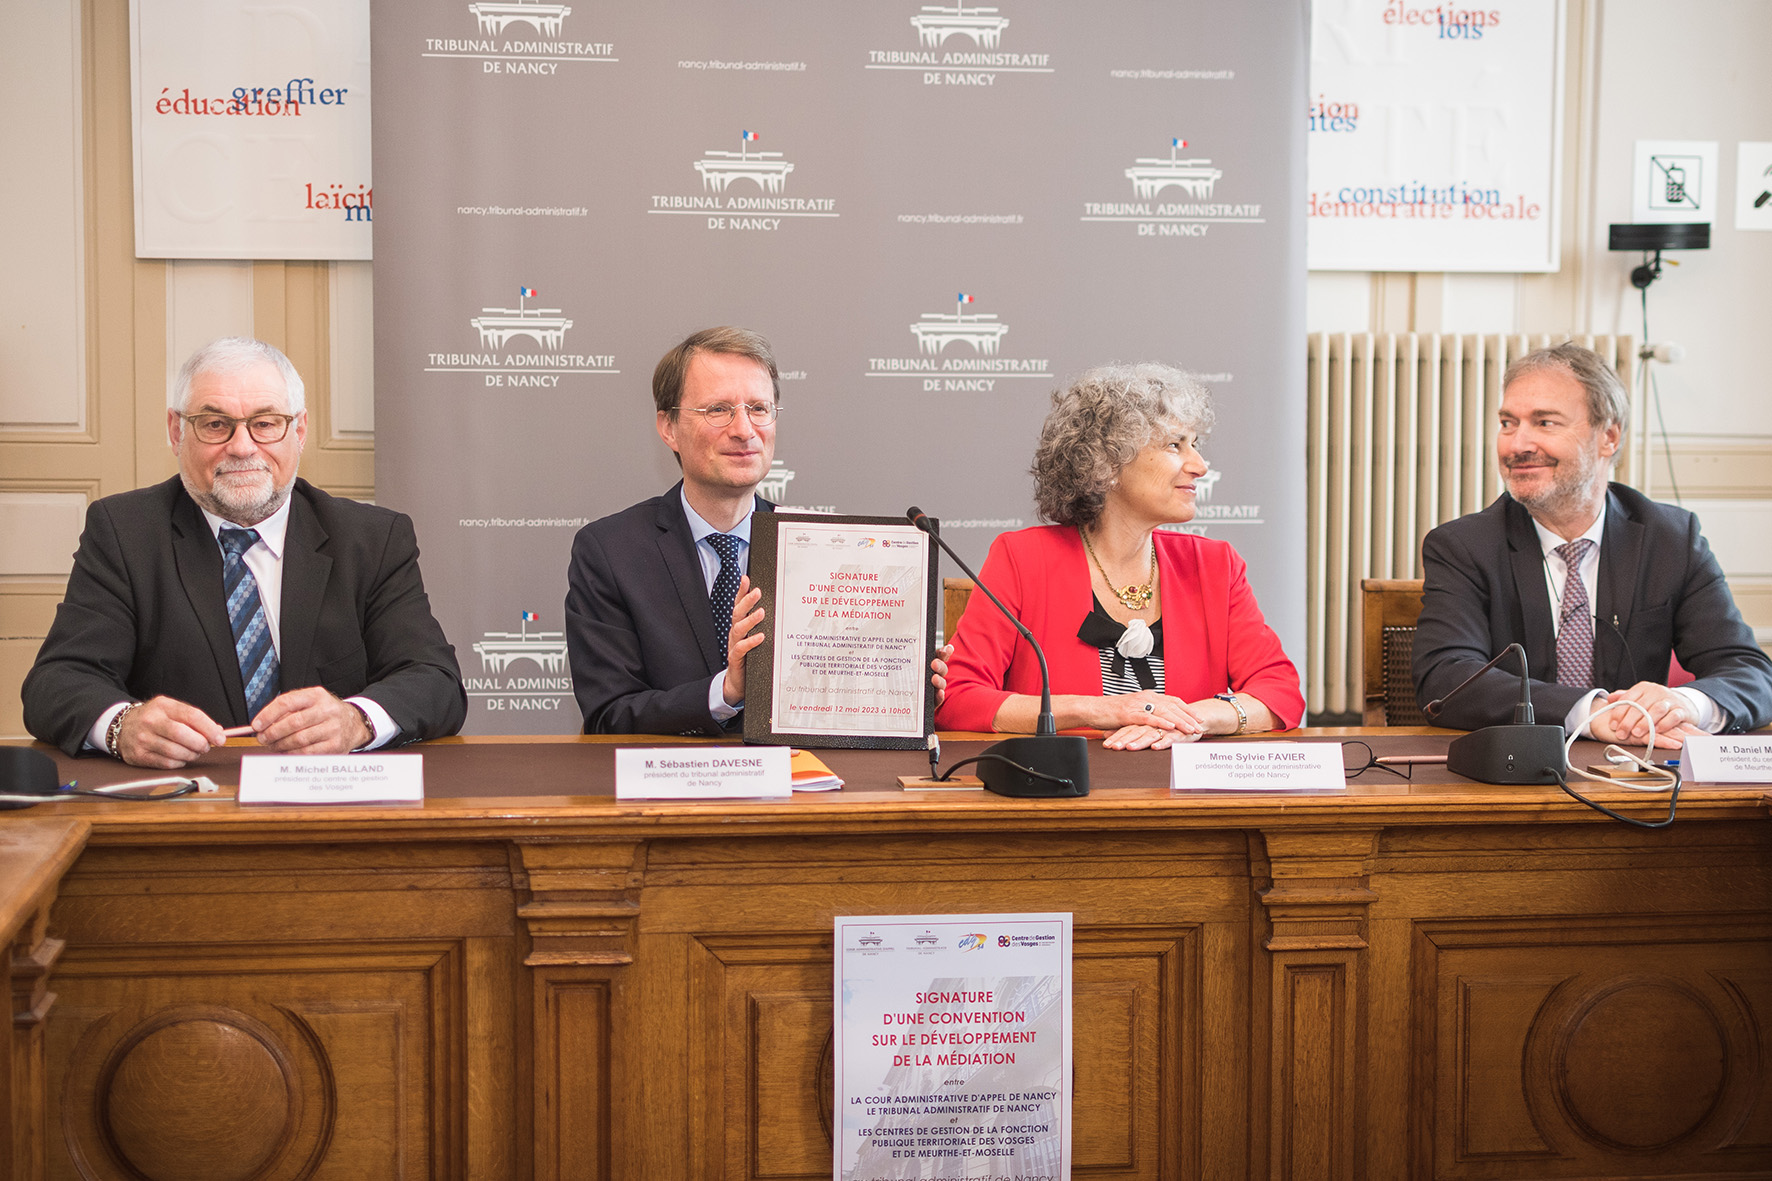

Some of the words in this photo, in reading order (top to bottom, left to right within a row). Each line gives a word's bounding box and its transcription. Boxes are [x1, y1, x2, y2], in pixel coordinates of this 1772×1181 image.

[1383, 0, 1501, 27] élections
[1438, 13, 1483, 40] lois
[426, 39, 498, 52] TRIBUNAL
[503, 41, 614, 55] ADMINISTRATIF
[678, 59, 807, 72] nancy.tribunal-administratif.fr
[868, 51, 938, 65] TRIBUNAL
[942, 52, 1049, 67] ADMINISTRATIF
[483, 62, 501, 73] DE
[506, 62, 557, 75] NANCY
[924, 72, 941, 85] DE
[946, 73, 996, 86] NANCY
[232, 78, 348, 111] greffier
[156, 88, 301, 116] éducation
[1339, 180, 1500, 206] constitution
[652, 196, 722, 209] TRIBUNAL
[726, 197, 835, 211] ADMINISTRATIF
[1085, 202, 1153, 216] TRIBUNAL
[1157, 204, 1262, 217] ADMINISTRATIF
[1463, 196, 1541, 220] locale
[457, 204, 588, 217] nancy.tribunal-administratif.fr
[707, 218, 726, 230] DE
[730, 218, 781, 231] NANCY
[897, 212, 1024, 225] nancy.tribunal-administratif.fr
[1138, 224, 1156, 236] DE
[1159, 224, 1209, 237] NANCY
[428, 353, 500, 366] TRIBUNAL
[504, 354, 615, 367] ADMINISTRATIF
[868, 358, 938, 371] TRIBUNAL
[942, 358, 1048, 372] ADMINISTRATIF
[485, 374, 503, 387] DE
[508, 375, 559, 388] NANCY
[924, 378, 941, 391] DE
[946, 378, 995, 391] NANCY
[830, 572, 878, 581] SIGNATURE
[809, 583, 835, 593] D'UNE
[837, 585, 898, 595] CONVENTION
[801, 596, 818, 605] SUR
[820, 597, 829, 605] LE
[832, 596, 905, 608] DÉVELOPPEMENT
[814, 609, 825, 618] DE
[828, 610, 839, 618] LA
[841, 608, 891, 620] MÉDIATION
[799, 686, 827, 694] tribunal
[828, 687, 875, 695] administratif
[876, 688, 887, 696] de
[888, 689, 914, 697] Nancy
[487, 699, 505, 711] DE
[510, 699, 561, 710] NANCY
[799, 704, 833, 712] vendredi
[889, 707, 911, 715] 10h00
[1720, 746, 1731, 754] M.
[1733, 746, 1762, 754] Daniel
[645, 761, 657, 769] M.
[660, 760, 710, 769] Sébastien
[713, 759, 763, 768] DAVESNE
[1210, 753, 1233, 761] Mme
[1236, 753, 1265, 763] Sylvie
[1268, 753, 1306, 761] FAVIER
[295, 765, 329, 774] Michel
[332, 765, 384, 773] BALLAND
[644, 771, 678, 779] président
[691, 770, 719, 778] tribunal
[1267, 771, 1290, 779] Nancy
[916, 991, 993, 1004] SIGNATURE
[883, 1012, 925, 1025] D'UNE
[929, 1011, 1025, 1024] CONVENTION
[872, 1034, 897, 1047] SUR
[902, 1034, 916, 1046] LE
[921, 1030, 1037, 1046] DÉVELOPPEMENT
[893, 1054, 911, 1067] DE
[915, 1054, 932, 1066] LA
[936, 1050, 1015, 1066] MÉDIATION
[944, 1078, 965, 1086] entre
[851, 1097, 862, 1105] LA
[865, 1096, 892, 1105] COUR
[894, 1094, 968, 1104] ADMINISTRATIVE
[972, 1094, 1007, 1102] D'APPEL
[1009, 1093, 1021, 1101] DE
[1023, 1092, 1057, 1101] NANCY
[867, 1107, 876, 1116] LE
[878, 1106, 921, 1116] TRIBUNAL
[923, 1105, 991, 1114] ADMINISTRATIF
[993, 1105, 1005, 1113] DE
[1007, 1104, 1041, 1113] NANCY
[950, 1116, 958, 1124] et
[858, 1128, 873, 1137] LES
[875, 1128, 914, 1136] CENTRES
[917, 1127, 928, 1135] DE
[931, 1126, 970, 1135] GESTION
[973, 1126, 984, 1134] DE
[987, 1126, 998, 1134] LA
[1000, 1125, 1049, 1134] FONCTION
[872, 1138, 915, 1148] PUBLIQUE
[917, 1137, 976, 1147] TERRITORIALE
[979, 1137, 995, 1145] DES
[998, 1136, 1035, 1145] VOSGES
[892, 1150, 901, 1158] ET
[904, 1150, 916, 1158] DE
[918, 1148, 1015, 1158] MEURTHE-ET-MOSELLE
